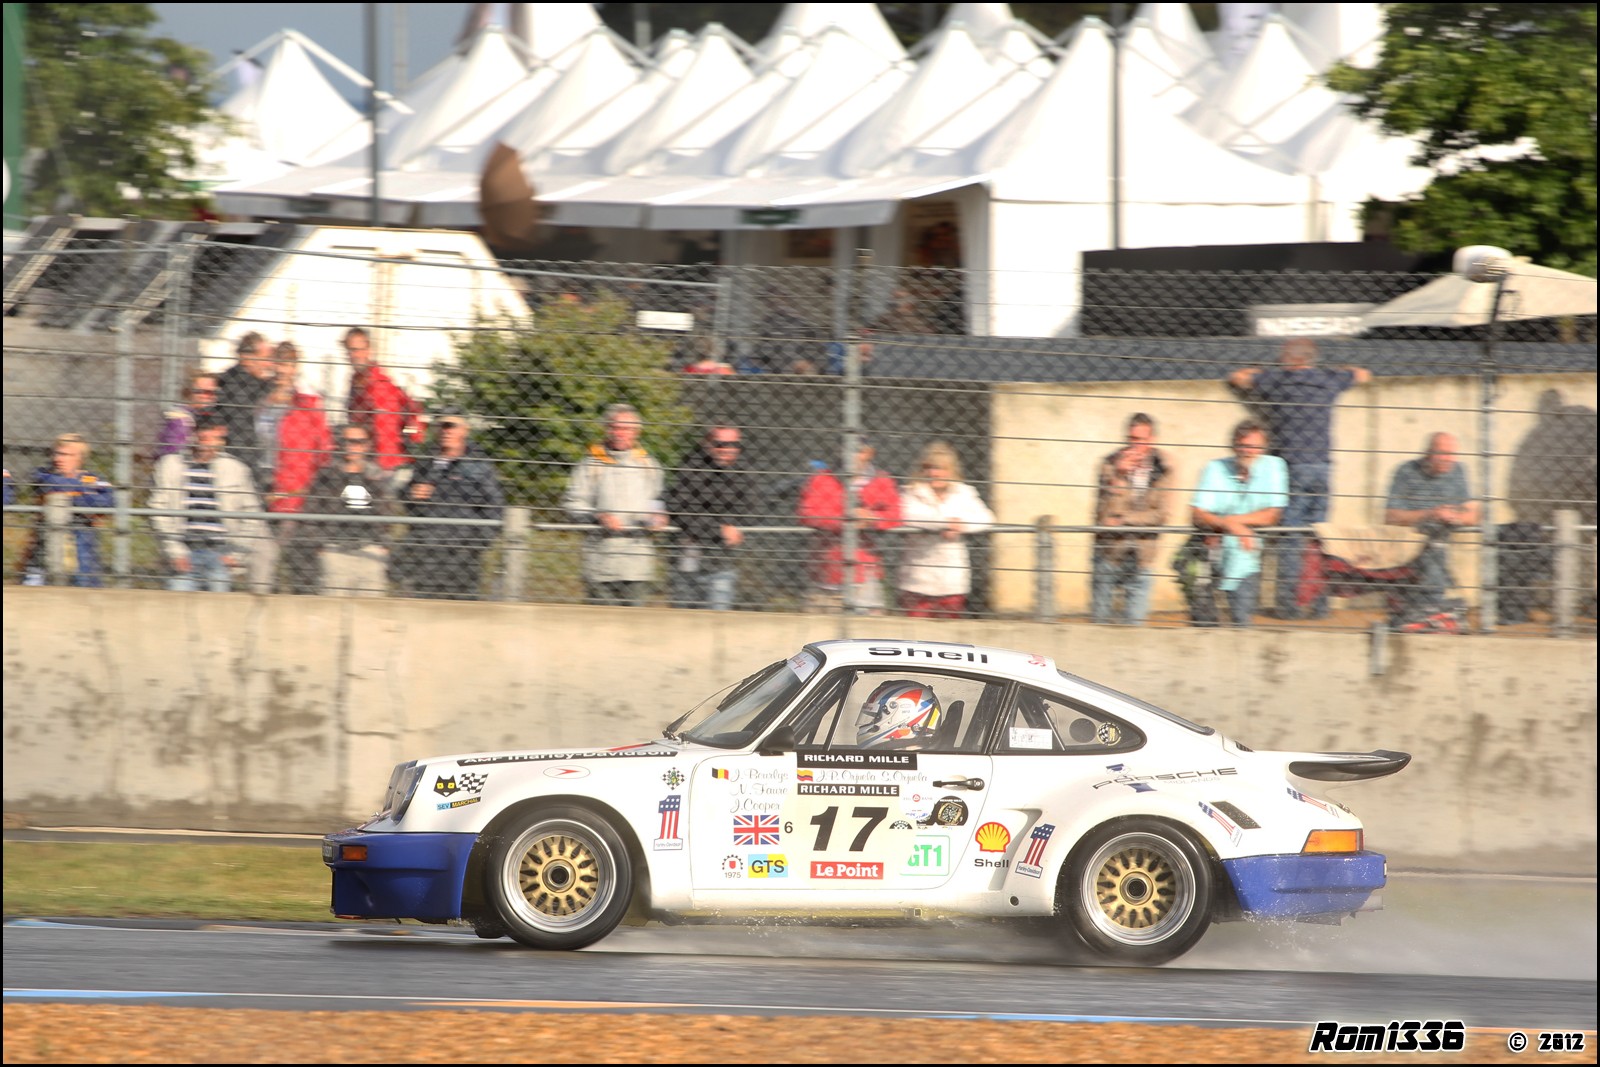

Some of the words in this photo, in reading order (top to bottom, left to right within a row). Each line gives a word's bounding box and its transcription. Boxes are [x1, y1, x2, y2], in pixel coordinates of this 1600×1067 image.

[868, 646, 988, 664] Shell
[804, 754, 864, 763] RICHARD
[868, 755, 910, 764] MILLE
[1092, 767, 1239, 790] PORSCHE
[800, 784, 856, 794] RICHARD
[860, 785, 898, 795] MILLE
[784, 821, 793, 833] 6
[810, 806, 889, 852] 17
[907, 844, 942, 867] GT1
[751, 859, 785, 873] GTS
[816, 863, 834, 876] Le
[836, 863, 879, 877] Point
[974, 858, 1009, 868] Shell
[724, 871, 741, 879] 1975
